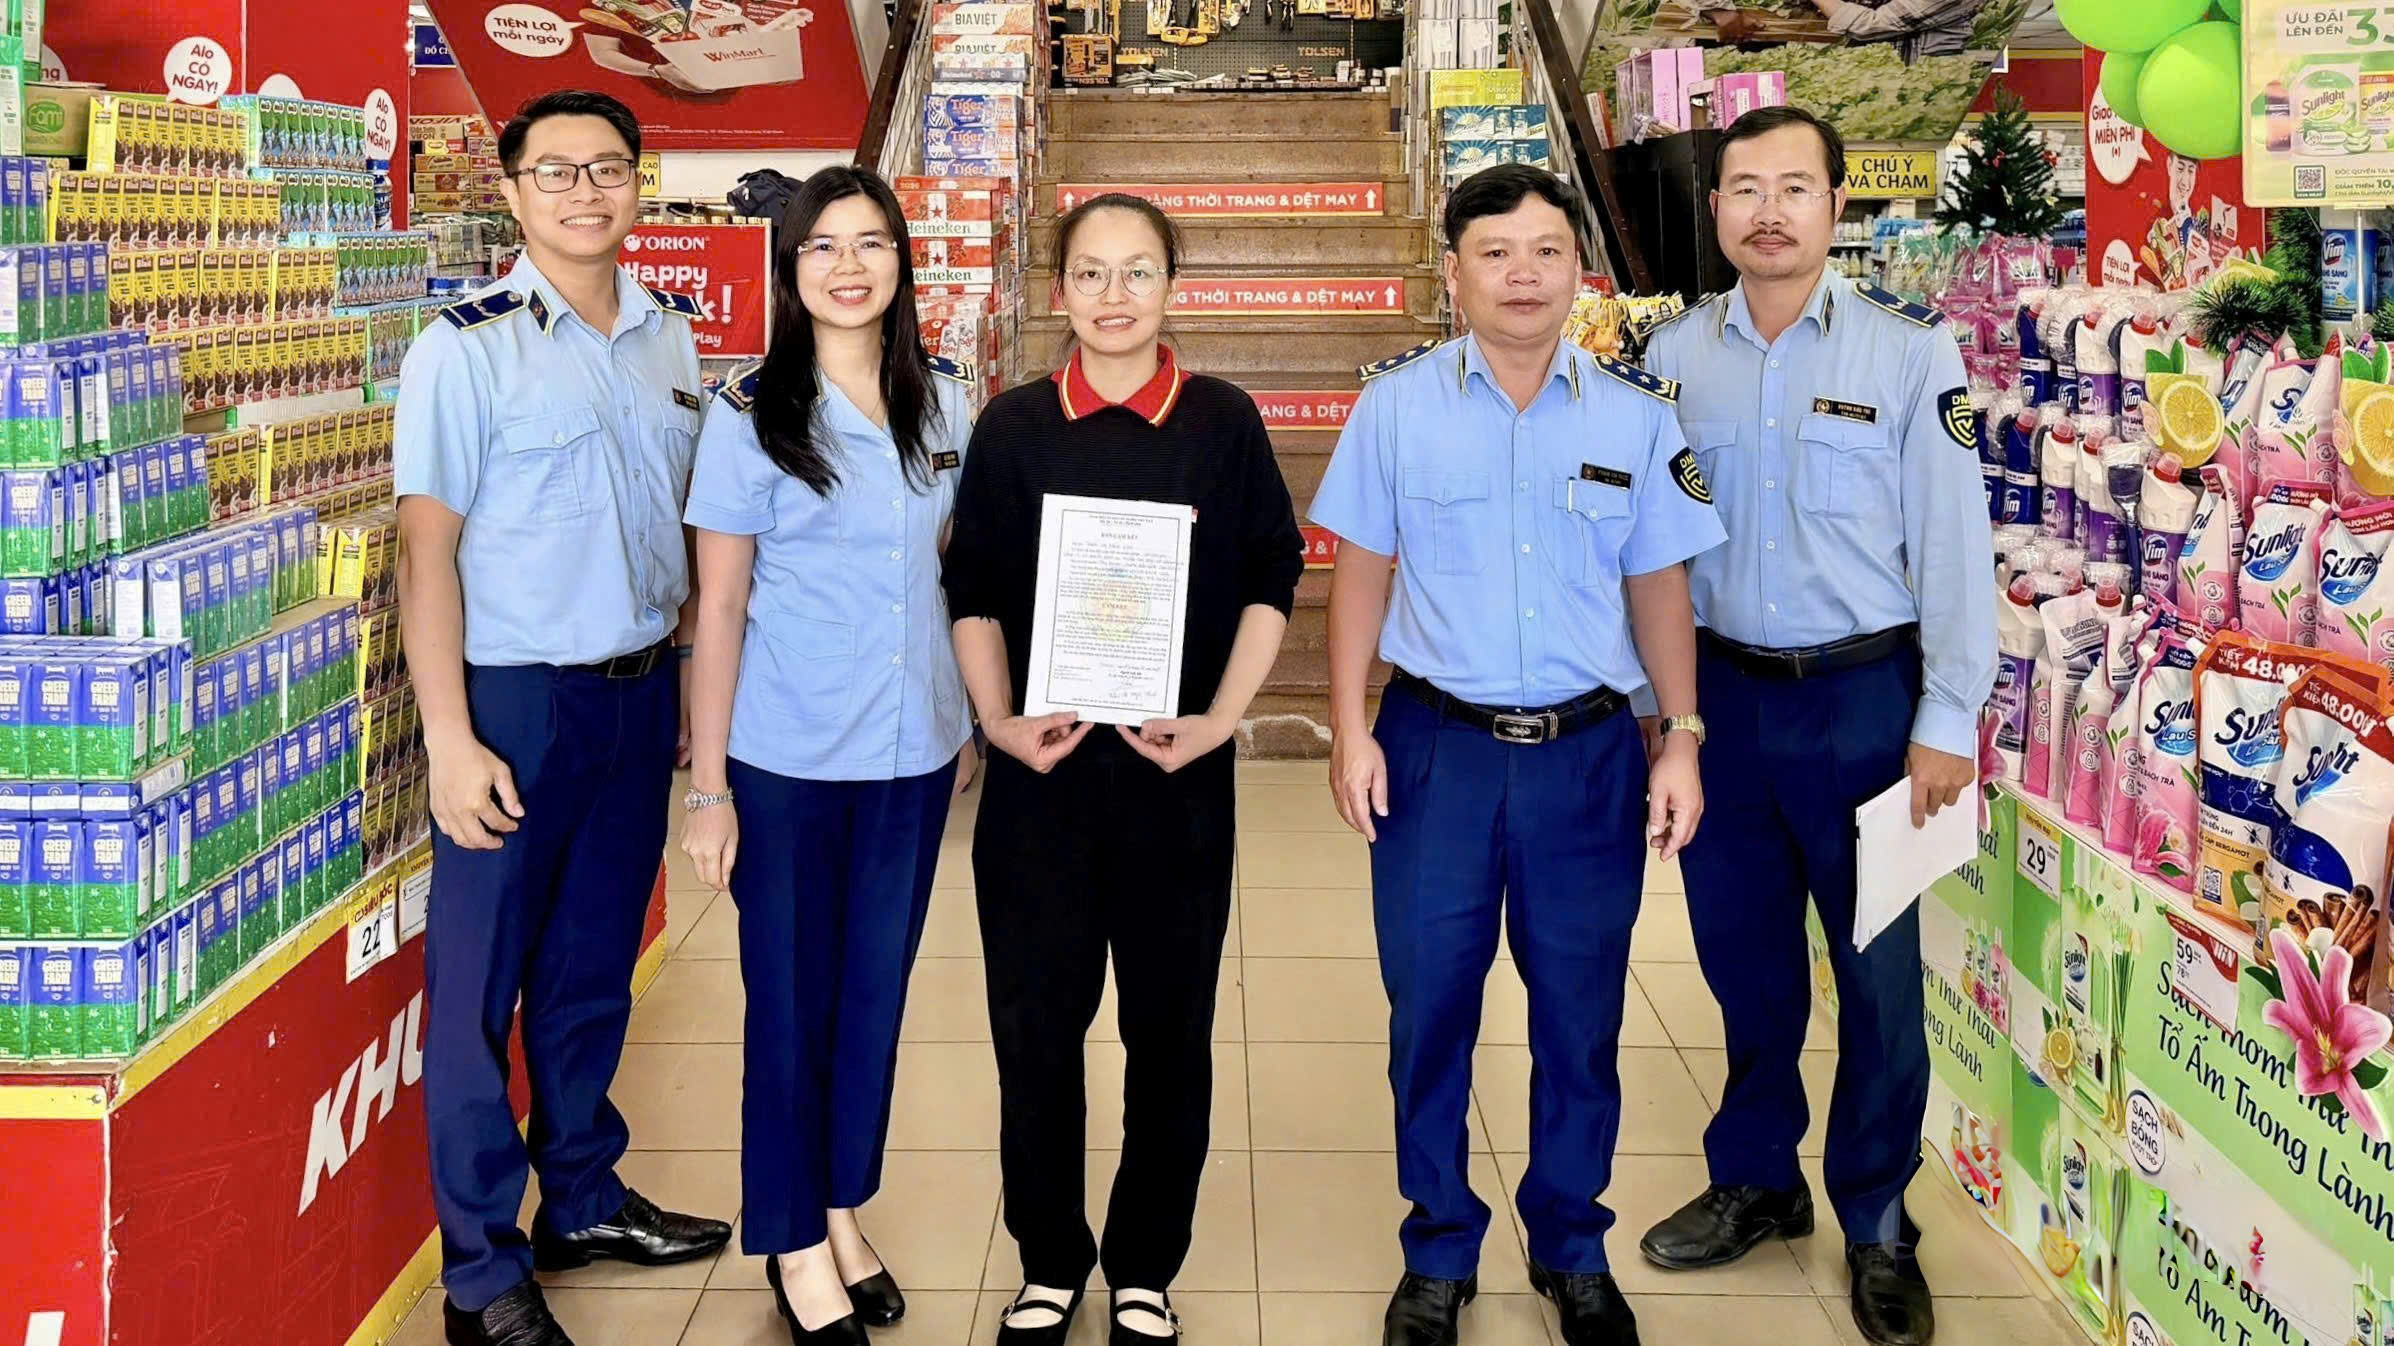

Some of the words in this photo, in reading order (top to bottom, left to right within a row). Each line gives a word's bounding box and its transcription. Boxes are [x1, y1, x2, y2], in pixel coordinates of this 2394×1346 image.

[2286, 26, 2311, 37] LÊN
[2315, 23, 2343, 36] ĐẾN
[703, 47, 764, 62] WinMart
[1298, 46, 1345, 57] TOLSEN
[172, 73, 219, 94] NGAY!
[950, 98, 984, 115] Tiger
[2302, 90, 2345, 115] Sunlight
[950, 130, 984, 147] Tiger
[642, 162, 659, 170] CAO
[1862, 154, 1897, 173] CHÚ
[1904, 154, 1914, 173] Ý
[1847, 174, 1870, 188] VA
[1876, 174, 1929, 192] CHẠM
[1227, 194, 1277, 207] TRANG
[1279, 194, 1290, 206] &
[1293, 191, 1323, 209] DỆT
[1325, 193, 1357, 206] MAY
[645, 236, 705, 251] ORION
[2323, 242, 2345, 261] Vim
[623, 261, 708, 290] Happy
[912, 269, 972, 282] eineken
[1192, 288, 1229, 304] THỜI
[1233, 291, 1289, 304] TRANG
[1291, 291, 1302, 304] &
[1306, 288, 1337, 307] DỆT
[1341, 290, 1376, 304] MAY
[692, 330, 723, 348] Play
[2123, 390, 2141, 409] Vim
[1301, 404, 1312, 418] &
[1316, 400, 1351, 422] DỆT
[1315, 540, 1328, 555] &
[2144, 542, 2167, 561] Vim
[2160, 775, 2175, 787] TRÀ
[2027, 838, 2046, 875] 29
[2214, 839, 2250, 860] BERGAMOT
[362, 918, 381, 958] 22
[2177, 937, 2193, 964] 59
[1949, 1032, 1983, 1084] Lành
[2131, 1099, 2159, 1134] SẠCH
[2159, 1014, 2184, 1060] Tổ
[2185, 1035, 2226, 1101] Ấm
[2235, 1076, 2308, 1176] Trong
[2318, 1146, 2394, 1242] Lành
[2130, 1121, 2159, 1155] BÓNG
